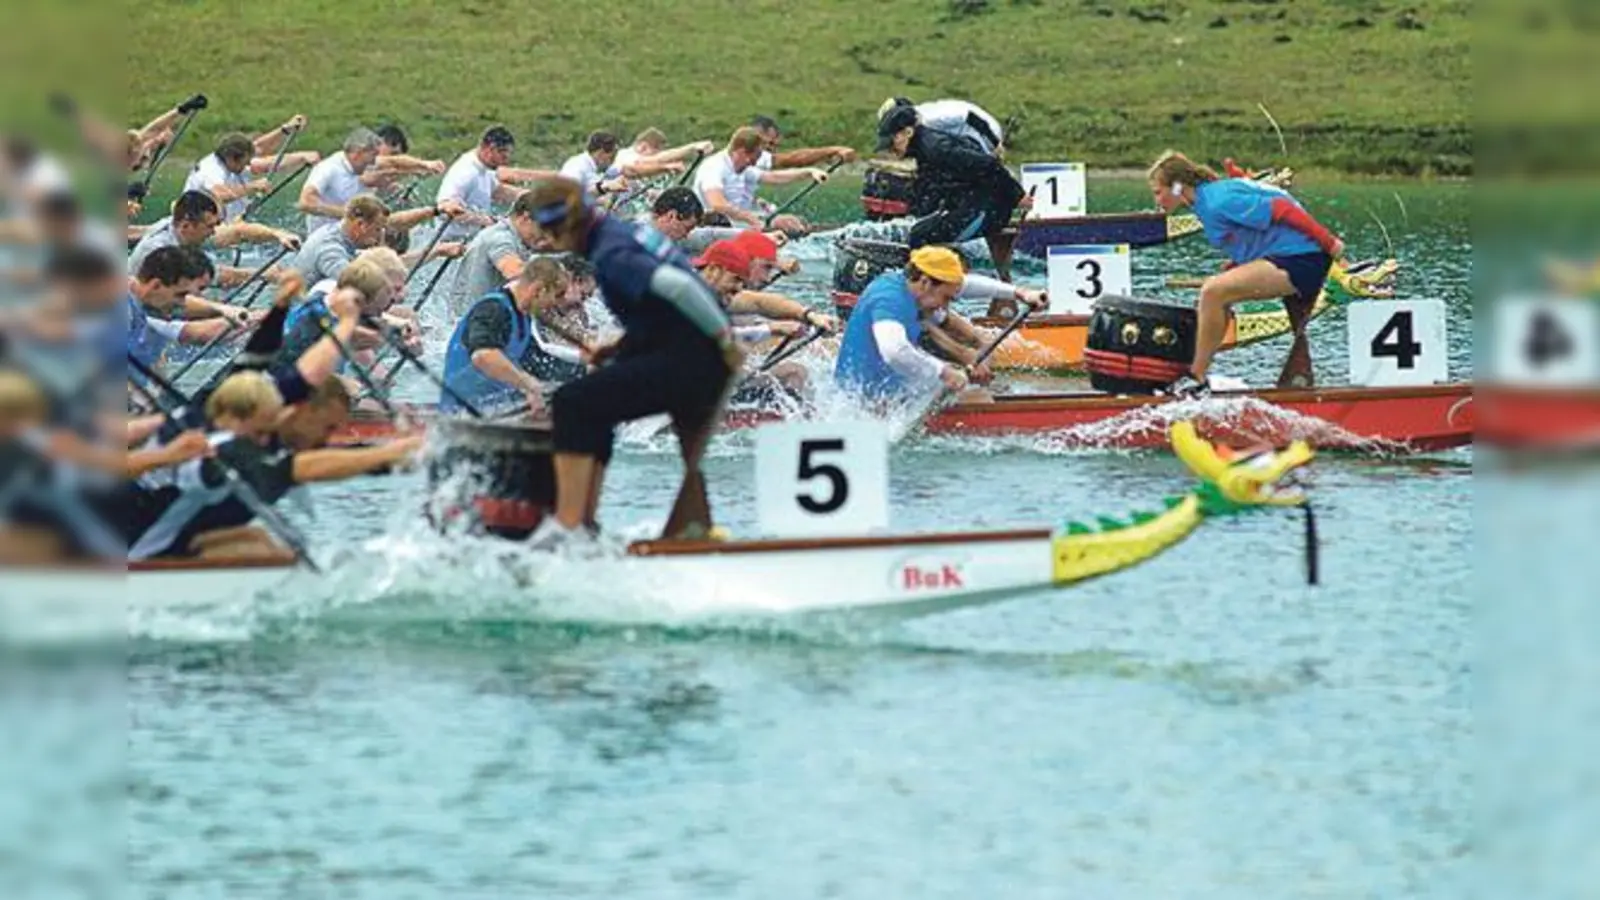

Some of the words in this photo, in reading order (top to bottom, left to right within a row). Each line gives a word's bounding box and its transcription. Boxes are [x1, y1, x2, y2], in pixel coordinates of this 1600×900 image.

[1046, 176, 1058, 205] 1
[1075, 259, 1103, 298] 3
[1370, 310, 1423, 370] 4
[794, 438, 849, 514] 5
